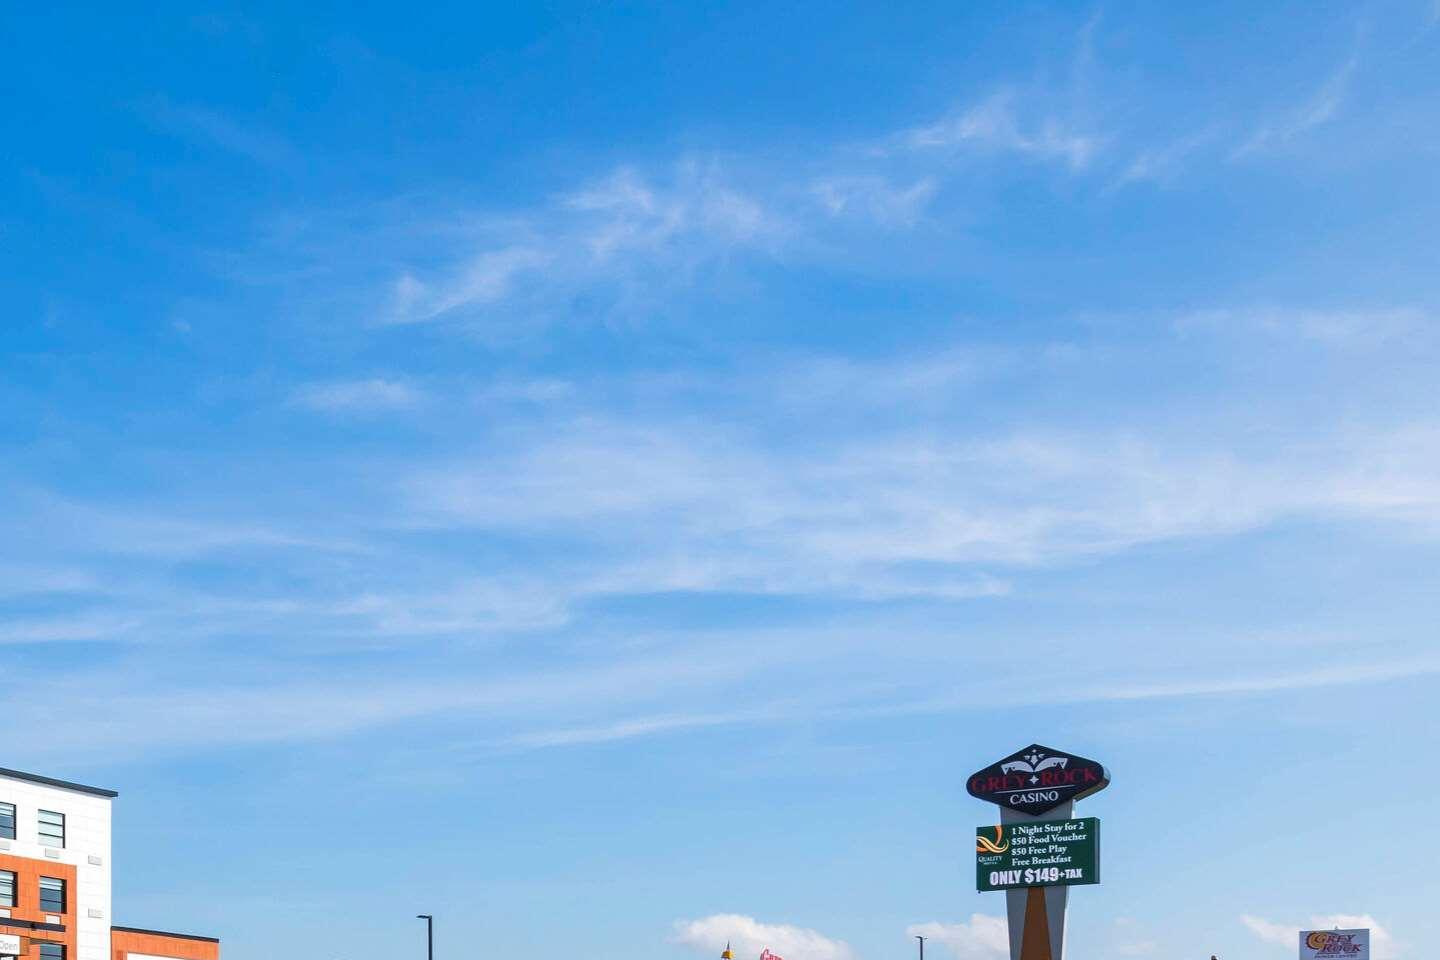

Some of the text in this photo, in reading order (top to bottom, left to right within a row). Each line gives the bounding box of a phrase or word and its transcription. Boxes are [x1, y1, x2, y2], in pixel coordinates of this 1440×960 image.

[970, 768, 1098, 792] GREY ROCK
[1010, 790, 1059, 805] CASINO
[1018, 825, 1043, 836] Night
[1044, 824, 1062, 834] Stay
[1011, 833, 1087, 846] $50 Food Voucher
[1011, 845, 1067, 856] $50 Free Play
[1012, 855, 1072, 867] Free Breakfast
[989, 869, 1022, 886] ONLY
[1321, 943, 1361, 953] ROCK
